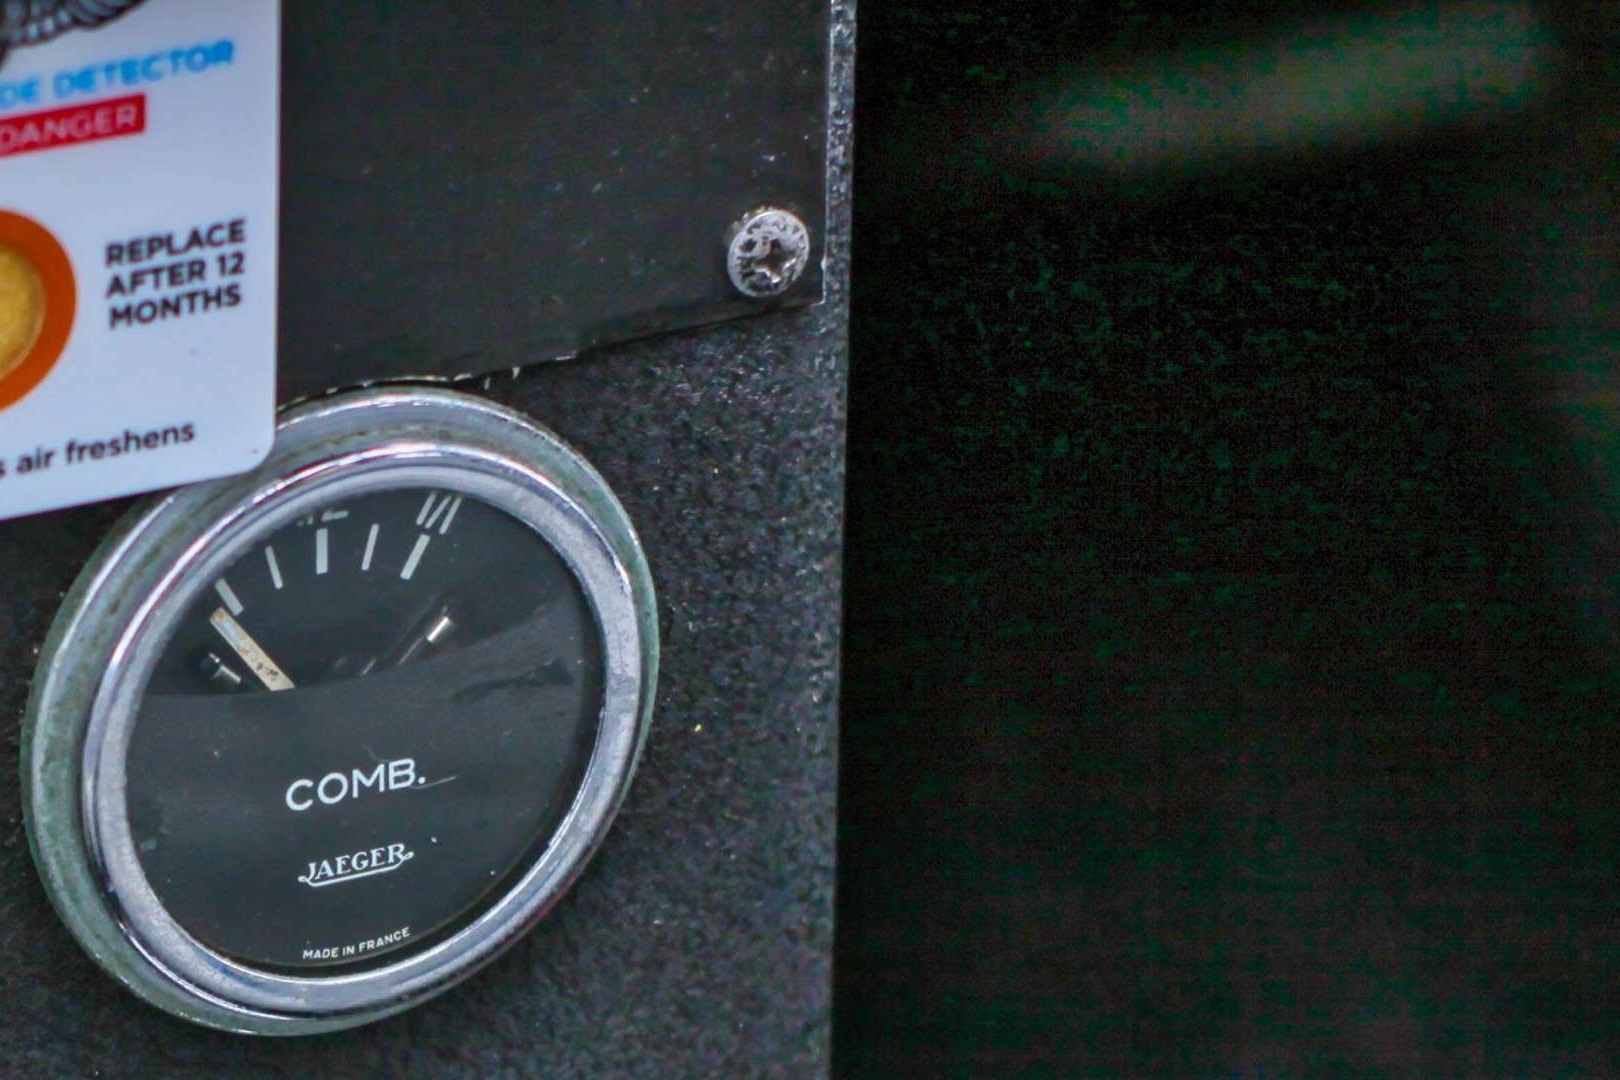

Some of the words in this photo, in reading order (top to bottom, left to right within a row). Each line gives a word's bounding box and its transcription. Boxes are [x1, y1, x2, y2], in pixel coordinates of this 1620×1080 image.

[54, 38, 235, 97] DETECTOR
[105, 216, 246, 269] REPLACE
[106, 258, 206, 298] AFTER
[216, 249, 245, 277] 12
[109, 282, 242, 330] MONTHS
[16, 446, 57, 475] air
[66, 420, 197, 465] freshens
[285, 757, 426, 812] COMB.
[297, 842, 416, 888] JAEGER
[302, 946, 339, 960] MADE
[342, 943, 356, 956] IN
[358, 926, 411, 953] FRANCE
